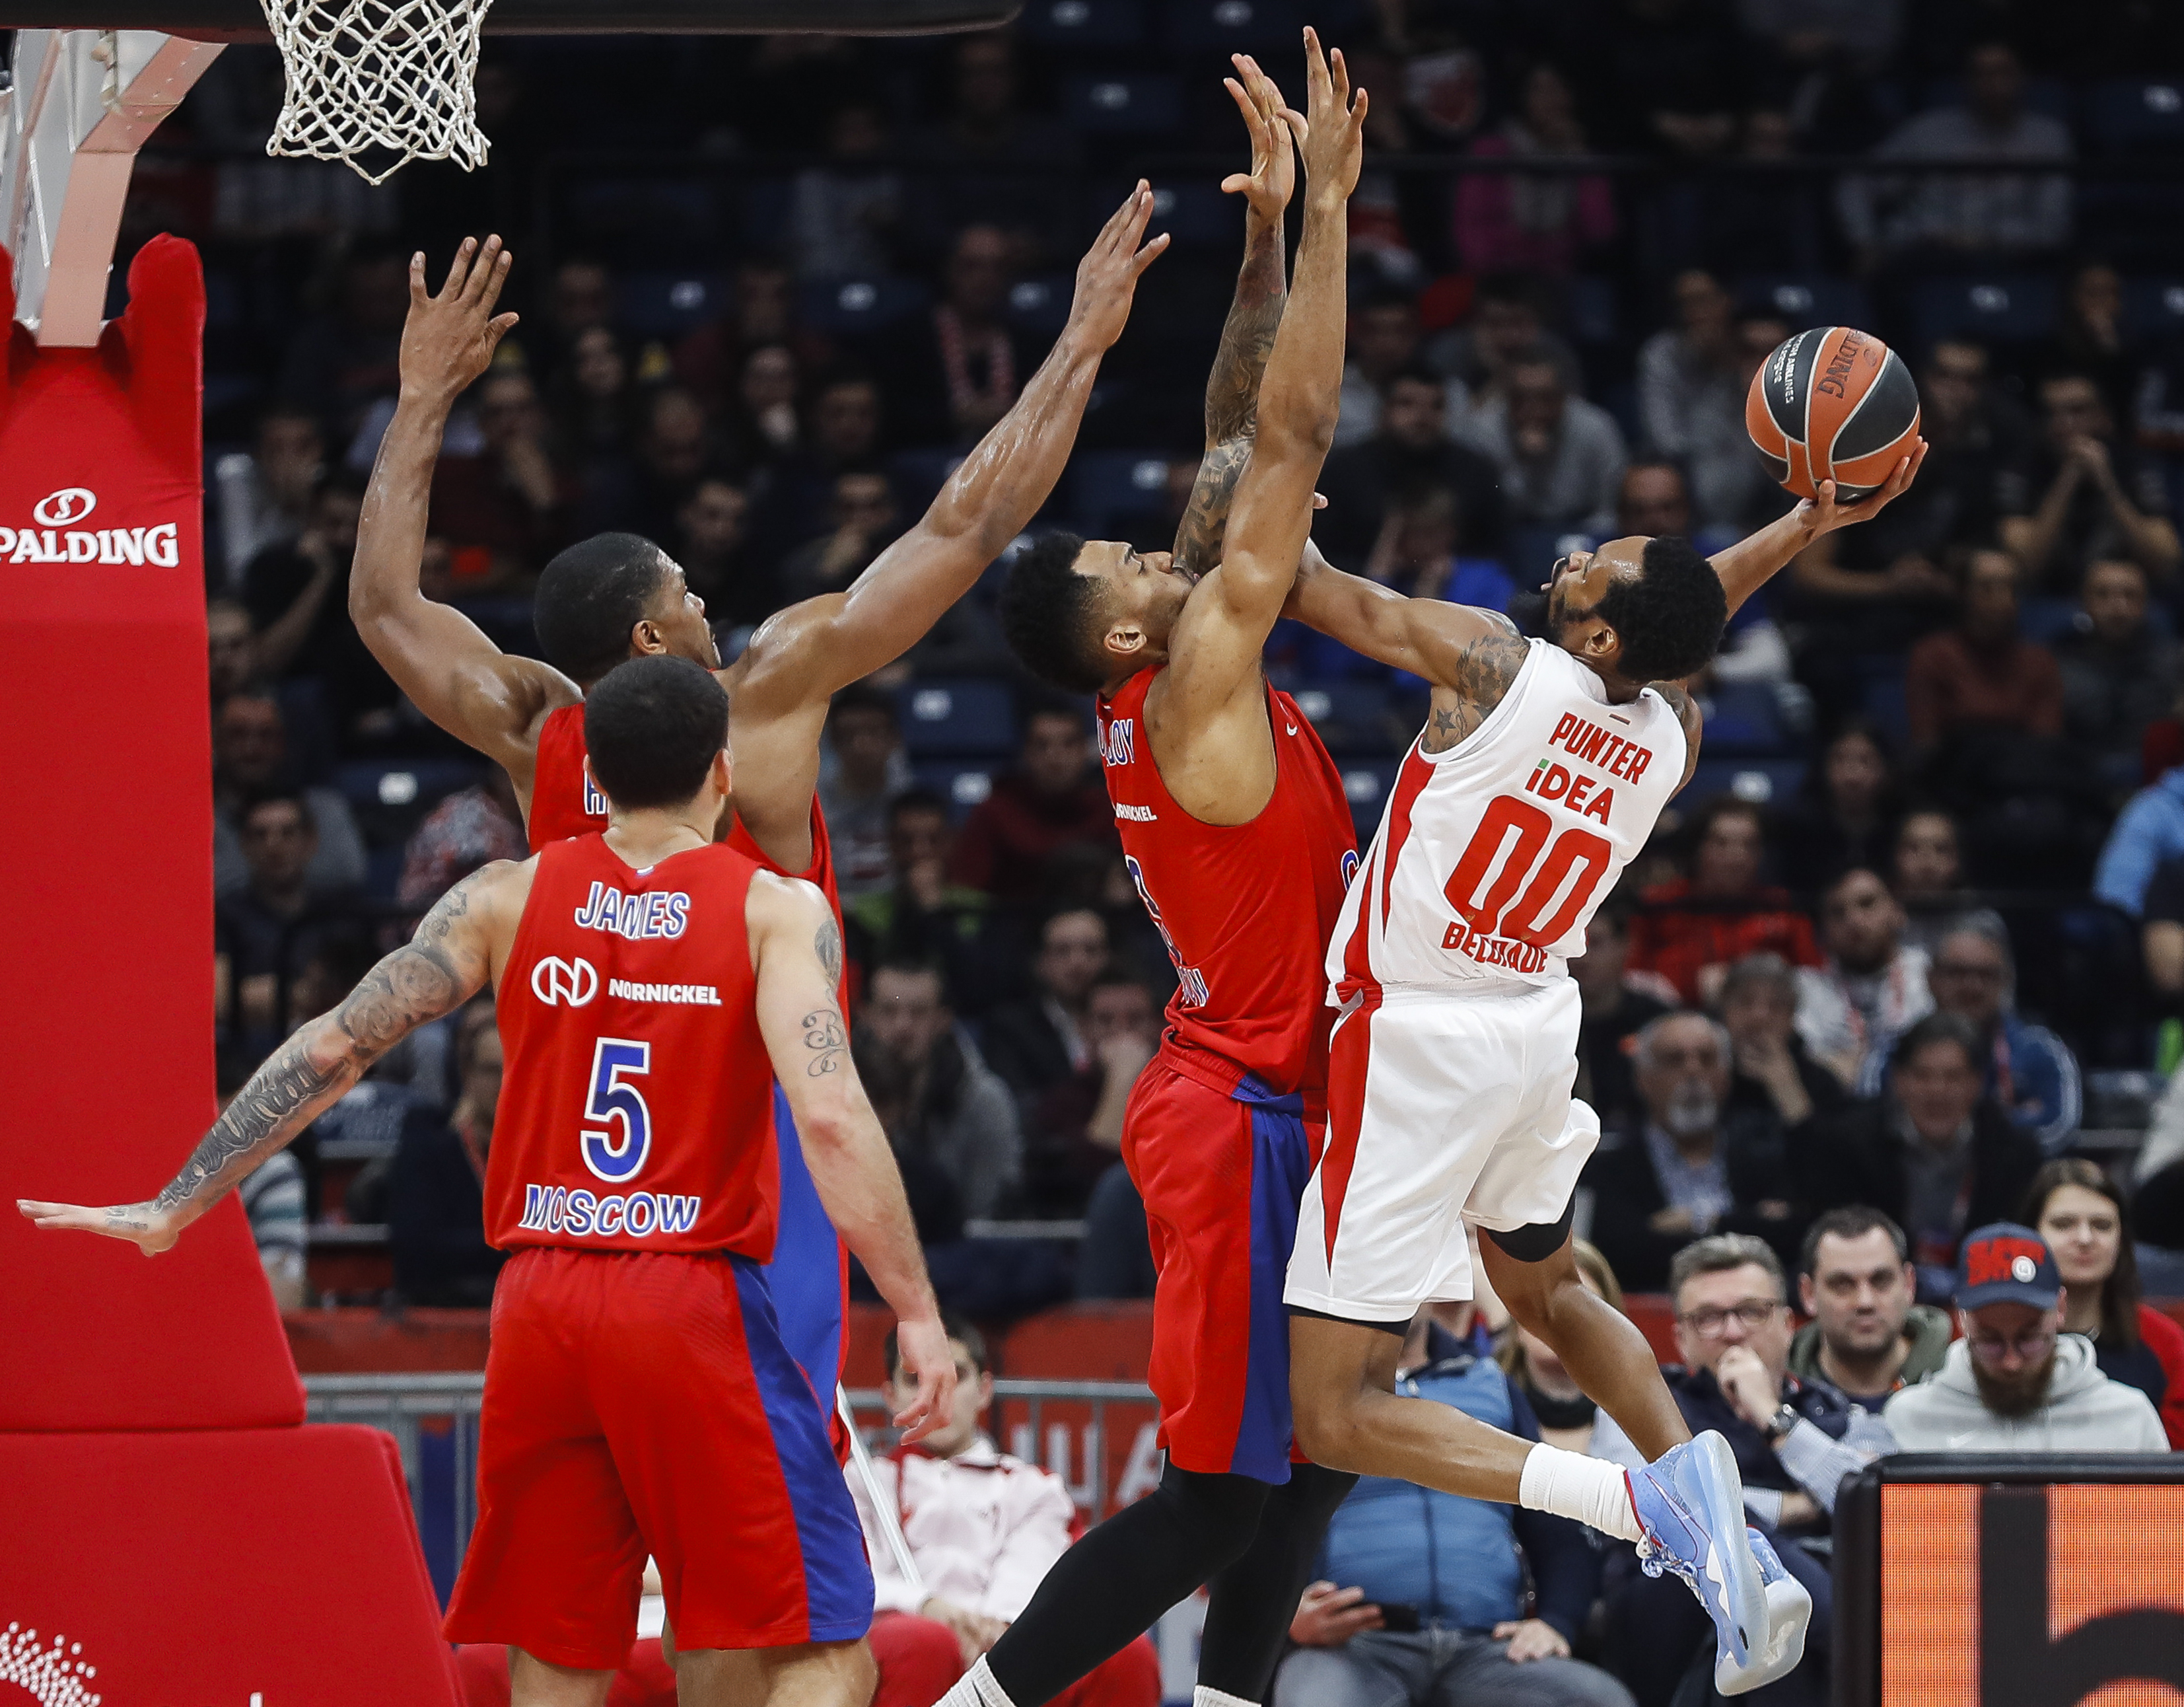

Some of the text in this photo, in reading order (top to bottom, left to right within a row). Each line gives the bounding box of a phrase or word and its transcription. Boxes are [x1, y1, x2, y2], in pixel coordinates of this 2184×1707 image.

[1784, 357, 1796, 405] AIRLINES
[0, 522, 179, 568] PALDING
[1548, 711, 1653, 785] PUNTER
[1444, 795, 1612, 947] 00
[575, 881, 691, 941] JAMES
[608, 978, 722, 1005] NORNICKEL
[580, 1036, 652, 1182] 5
[518, 1183, 701, 1237] MOSCOW
